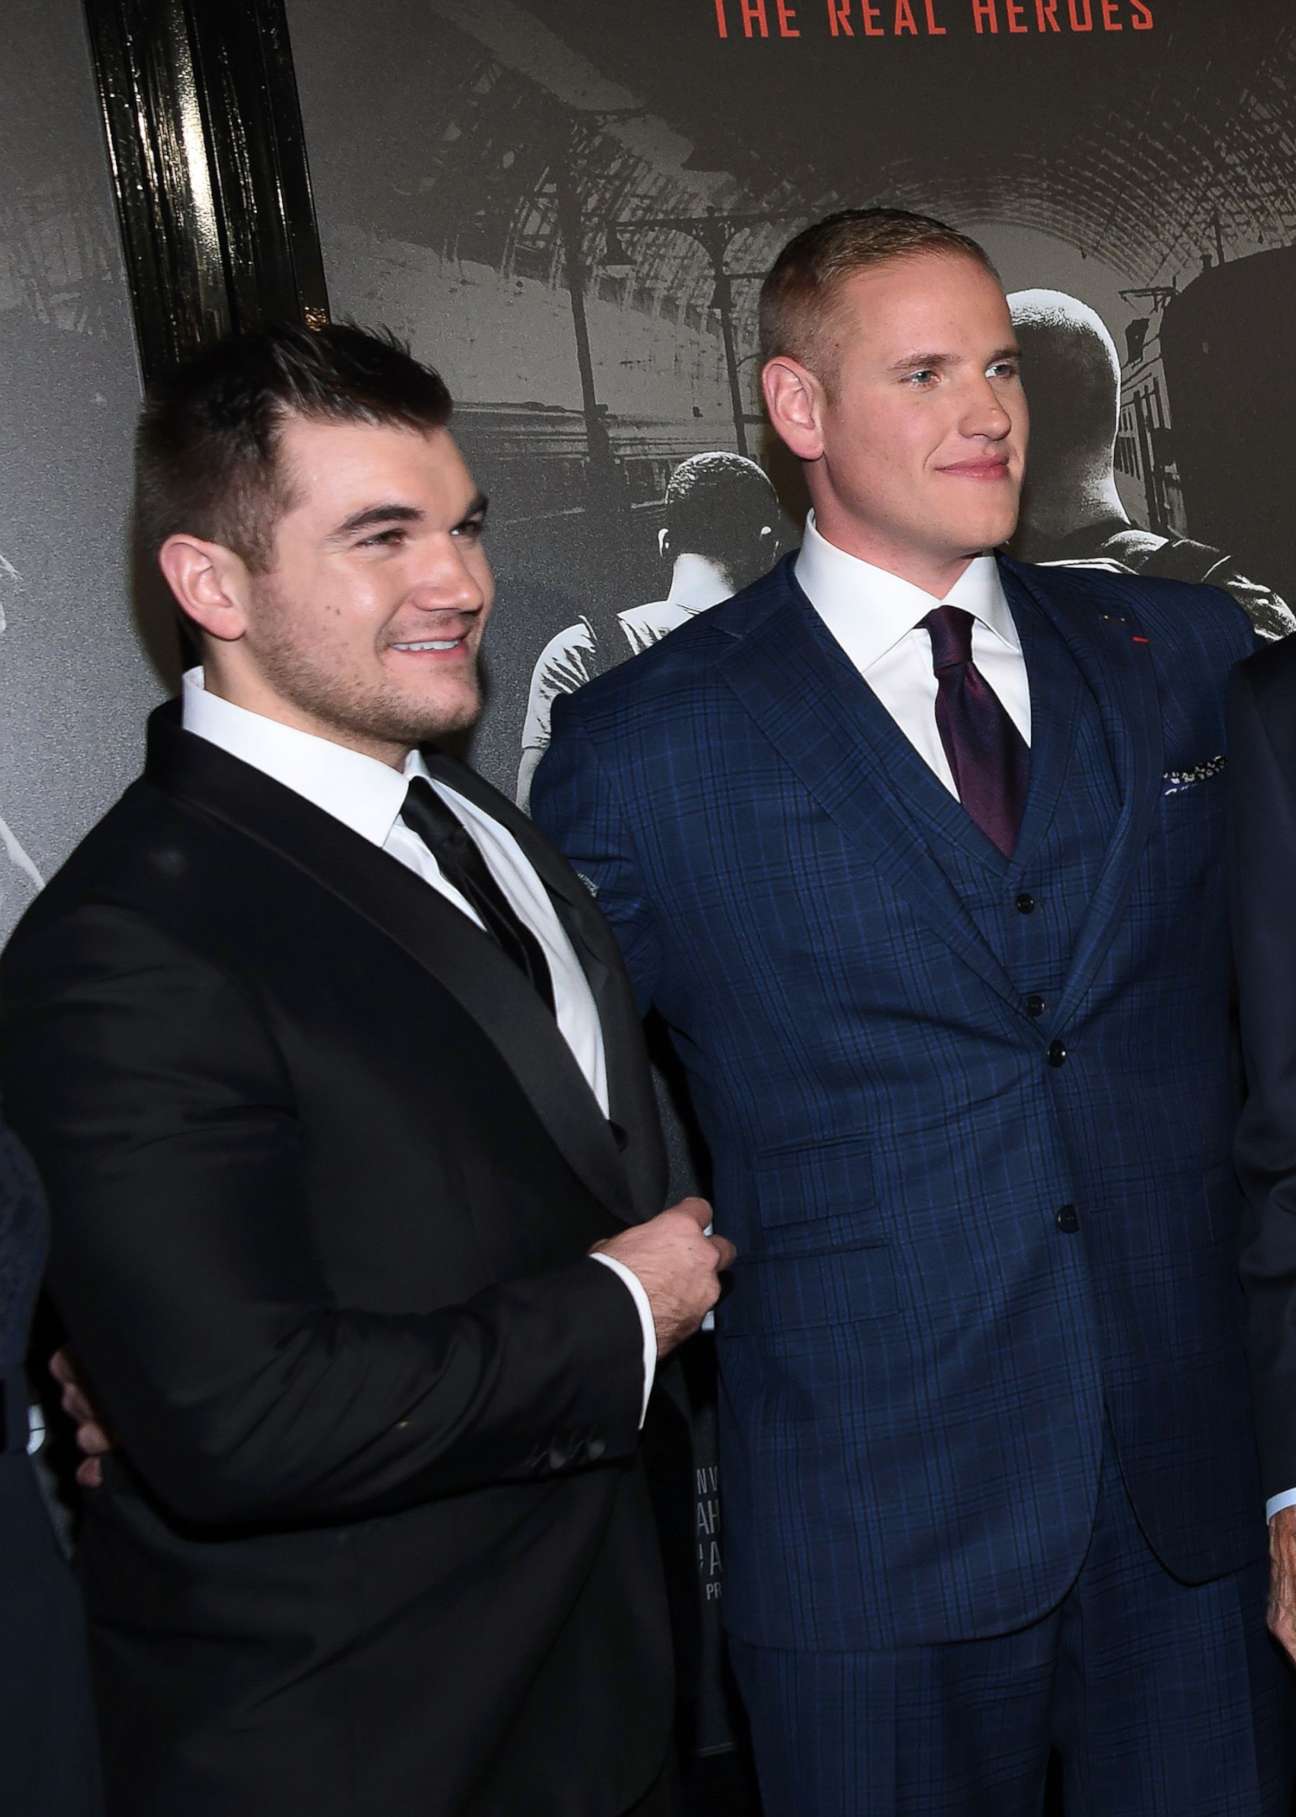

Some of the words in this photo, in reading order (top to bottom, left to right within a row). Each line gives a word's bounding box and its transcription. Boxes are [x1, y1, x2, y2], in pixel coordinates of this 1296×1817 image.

[714, 0, 801, 39] THE
[826, 0, 947, 37] REAL
[971, 0, 1155, 34] HEROES
